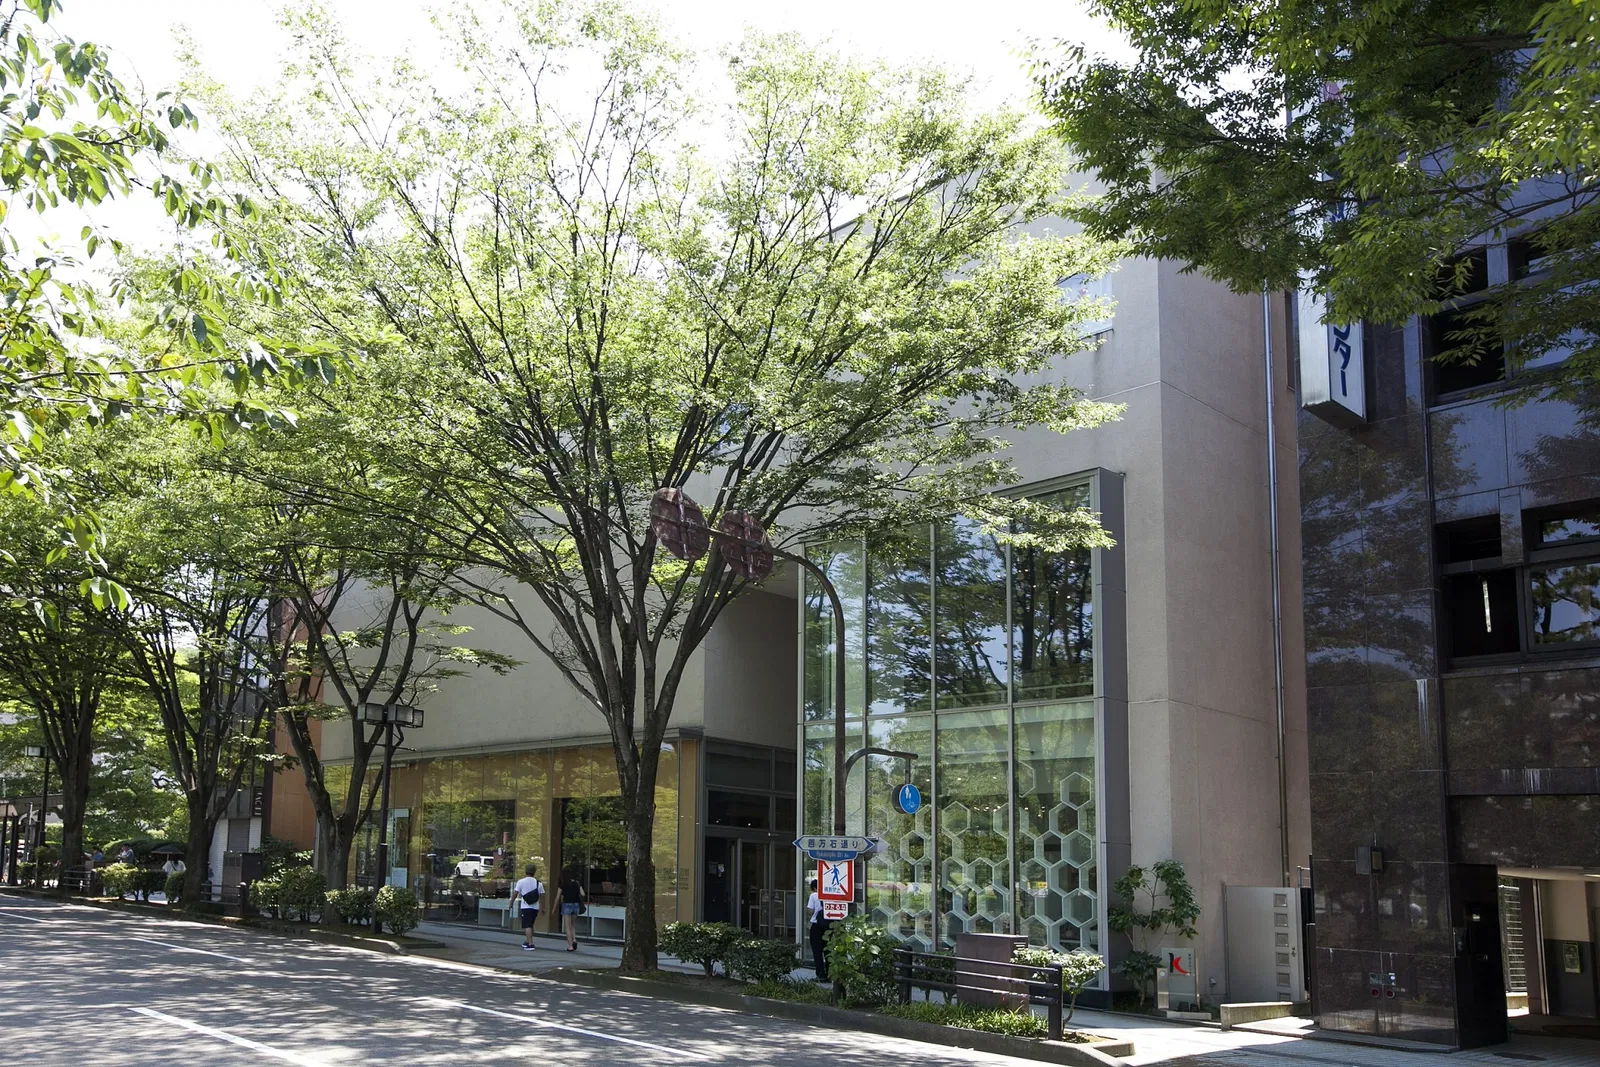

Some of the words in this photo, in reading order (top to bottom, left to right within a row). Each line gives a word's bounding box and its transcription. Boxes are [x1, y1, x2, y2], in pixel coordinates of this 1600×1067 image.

[808, 839, 859, 848] 百万石通り
